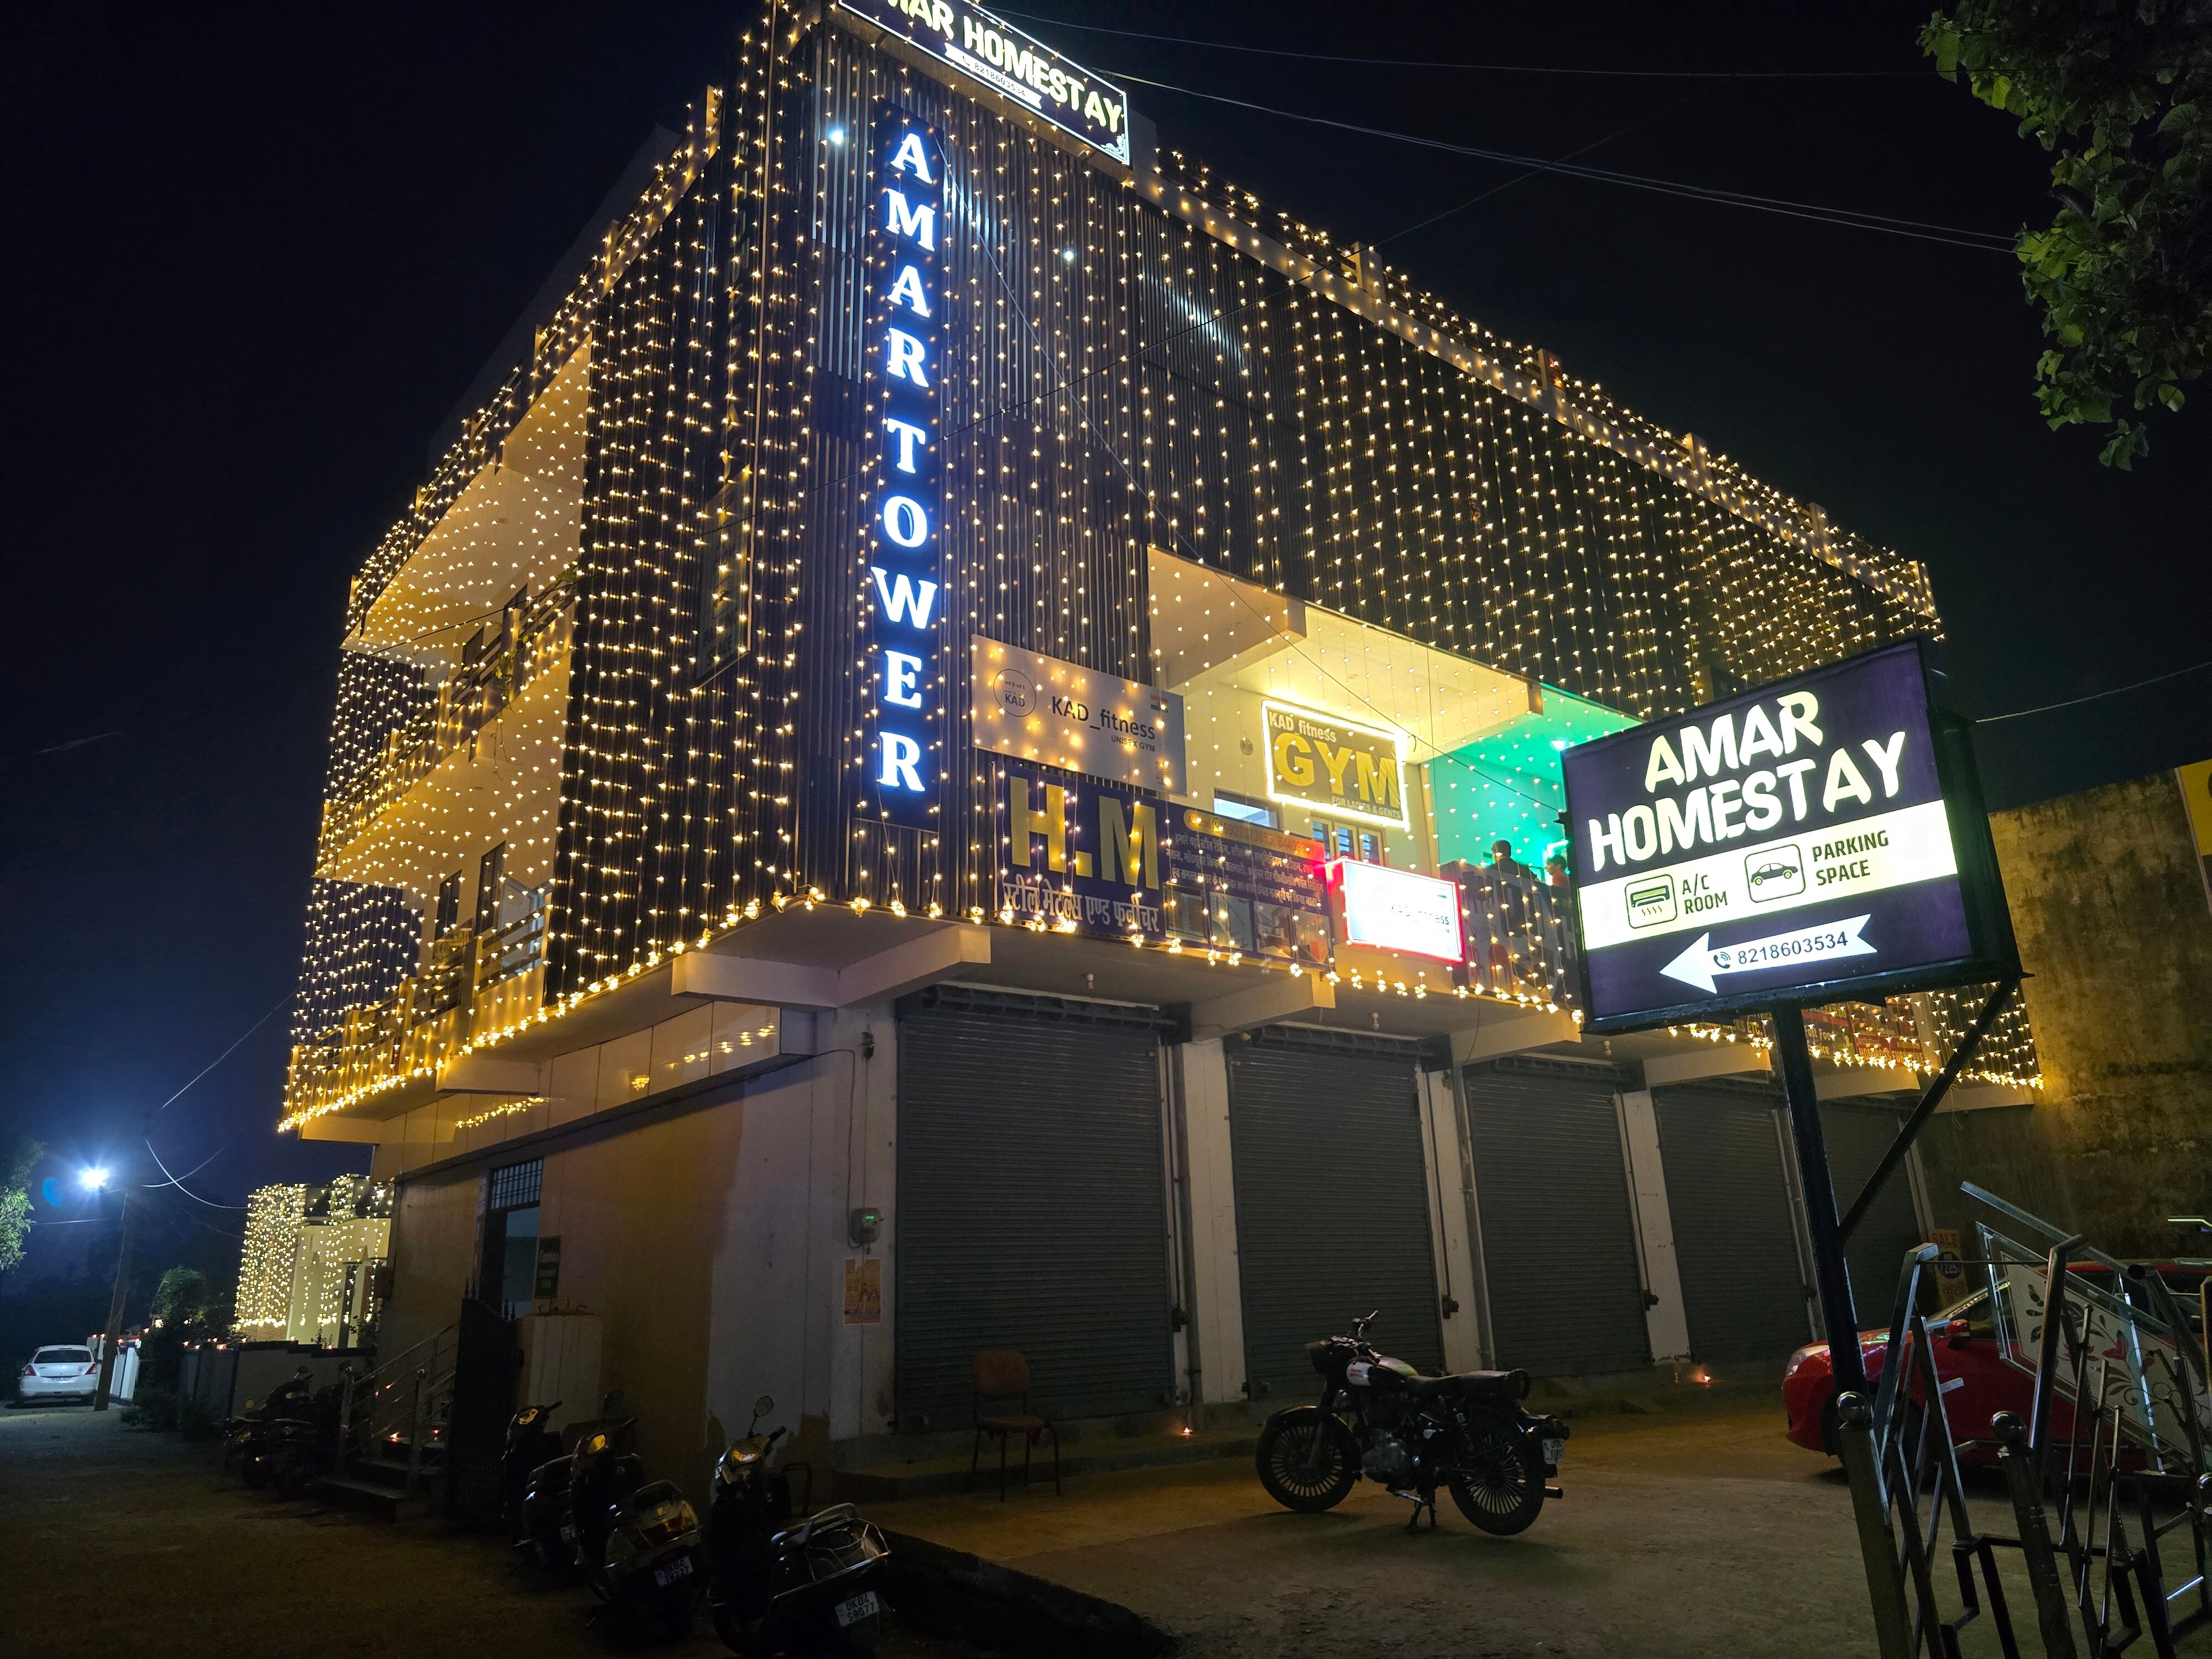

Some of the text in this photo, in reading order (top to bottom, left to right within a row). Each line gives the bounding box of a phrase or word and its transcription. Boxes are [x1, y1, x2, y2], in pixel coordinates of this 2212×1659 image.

[963, 15, 1122, 133] HOMESTAY
[975, 62, 1025, 96] 8218603534
[872, 133, 937, 791] AMAR TOWER
[1005, 693, 1025, 707] KAD
[1111, 734, 1155, 752] UNISEX GYM
[1645, 690, 1823, 793] AMAR
[1274, 732, 1399, 808] GYM
[1331, 796, 1400, 818] FOR LADIES & GENTS
[1588, 731, 1906, 872] HOMESTAY
[1812, 830, 1889, 862] PARKING
[1682, 873, 1709, 895] A/C
[1817, 859, 1870, 886] SPACE
[1002, 874, 1039, 912] स्टील
[1085, 896, 1110, 925] एण्ड
[1684, 891, 1728, 915] ROOM
[1738, 931, 1848, 964] 8218603534
[1932, 1232, 1958, 1247] SALE
